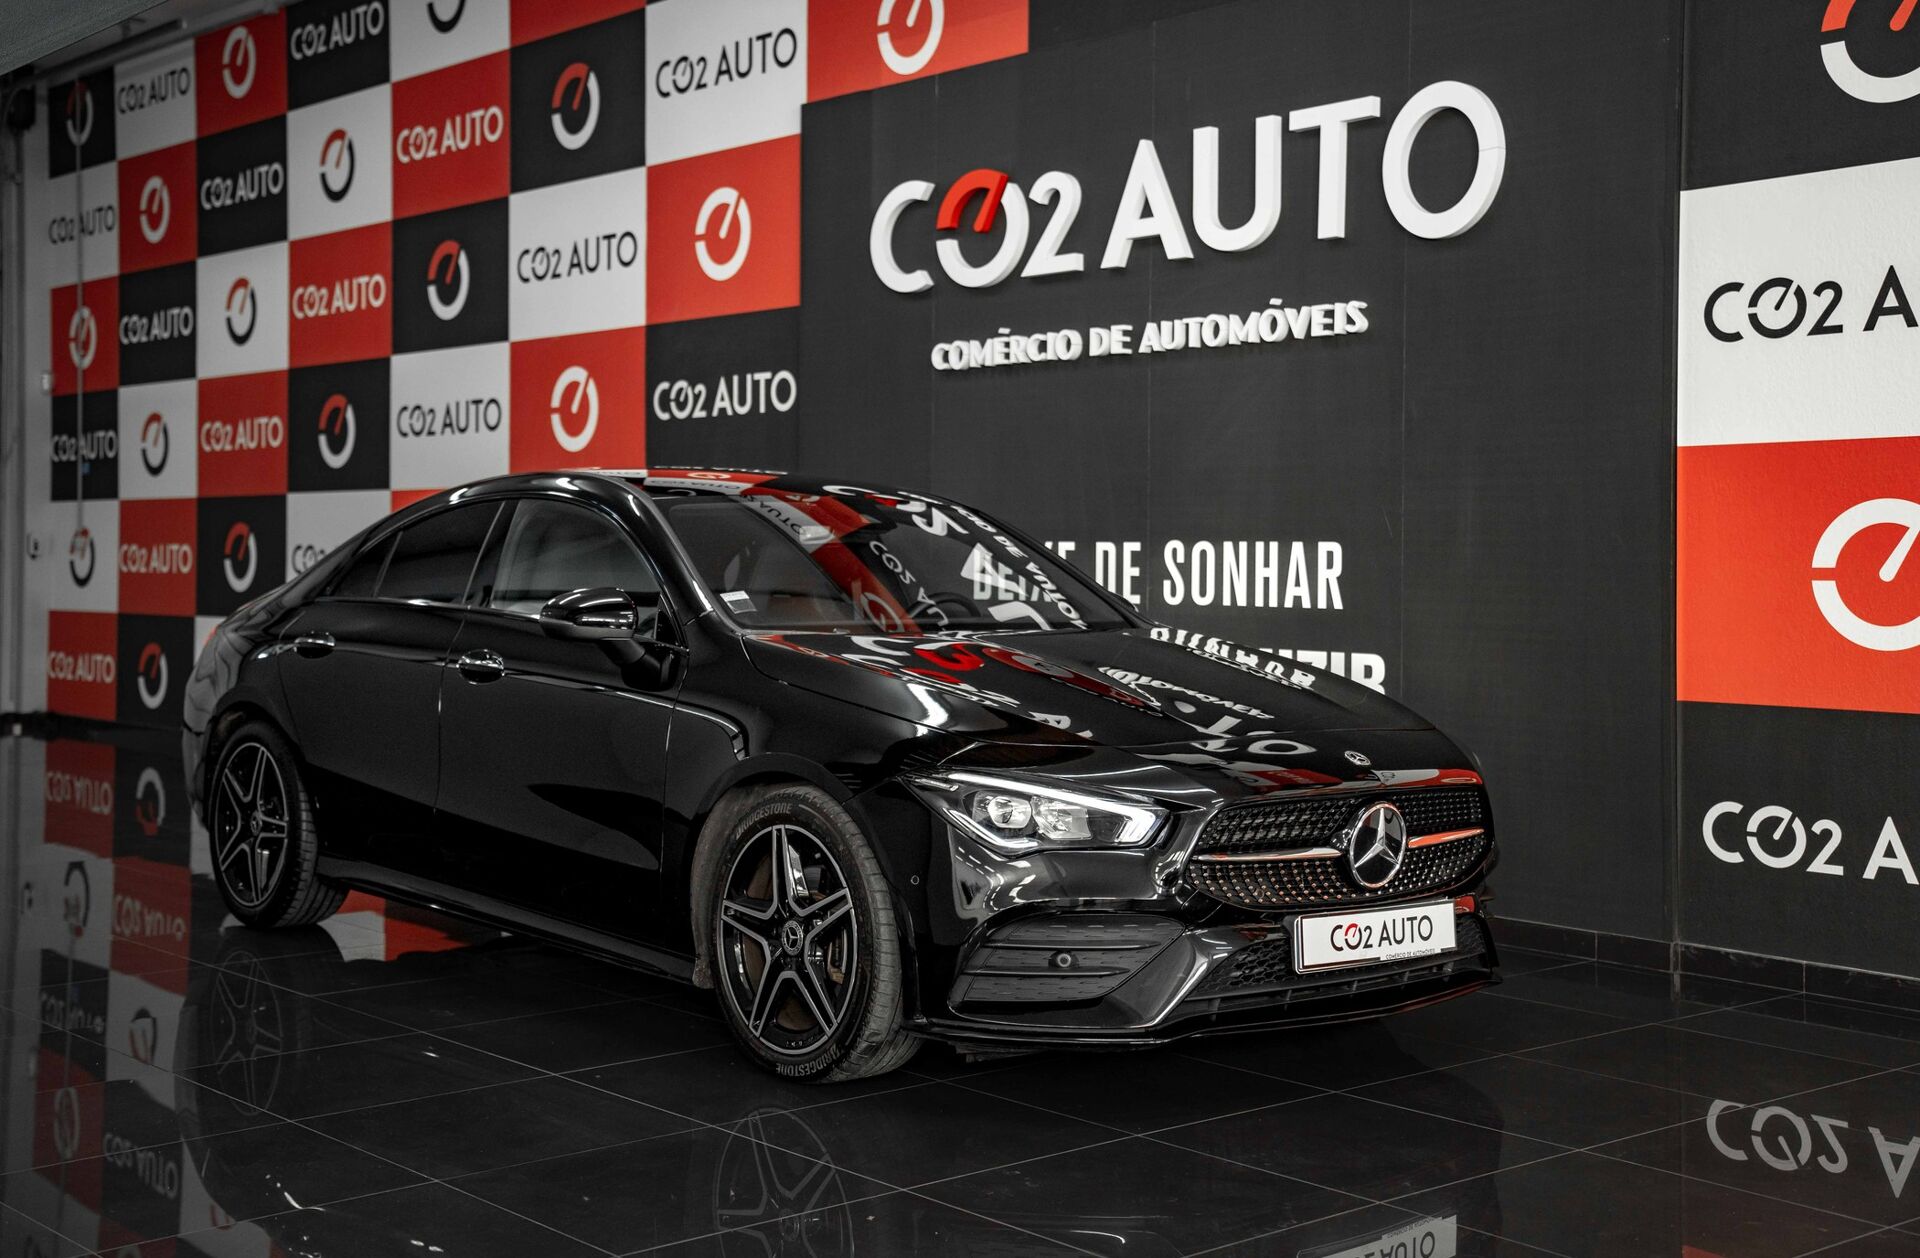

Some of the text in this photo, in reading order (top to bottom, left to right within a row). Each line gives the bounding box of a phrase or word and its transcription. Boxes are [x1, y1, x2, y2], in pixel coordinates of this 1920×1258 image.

[290, 2, 385, 60] CO2 AUTO
[656, 28, 798, 98] CO2 AUTO
[118, 67, 191, 114] CO2 AUTO
[397, 105, 504, 164] CO2 AUTO
[200, 162, 284, 210] CO2 AUTO
[869, 80, 1506, 293] CO2 AUTO
[517, 231, 638, 283] CO2 AUTO
[292, 274, 386, 319] CO2 AUTO
[1704, 277, 1844, 343] CO2
[119, 306, 193, 345] CO2 AUTO
[931, 297, 1369, 371] COMÉRCIO DE AUTOMÓVEIS
[397, 398, 501, 438] CO2 AUTO
[653, 370, 798, 421] CO2 AUTO
[200, 415, 283, 453] CO2 AUTO
[119, 544, 193, 574] CO2 AUTO
[292, 544, 326, 574] CO
[1095, 541, 1141, 604] DE
[1163, 540, 1344, 610] SONHAR
[48, 650, 116, 684] CO2 AUTO
[1703, 801, 1844, 876] CO2
[1330, 915, 1433, 951] CO2 AUTO
